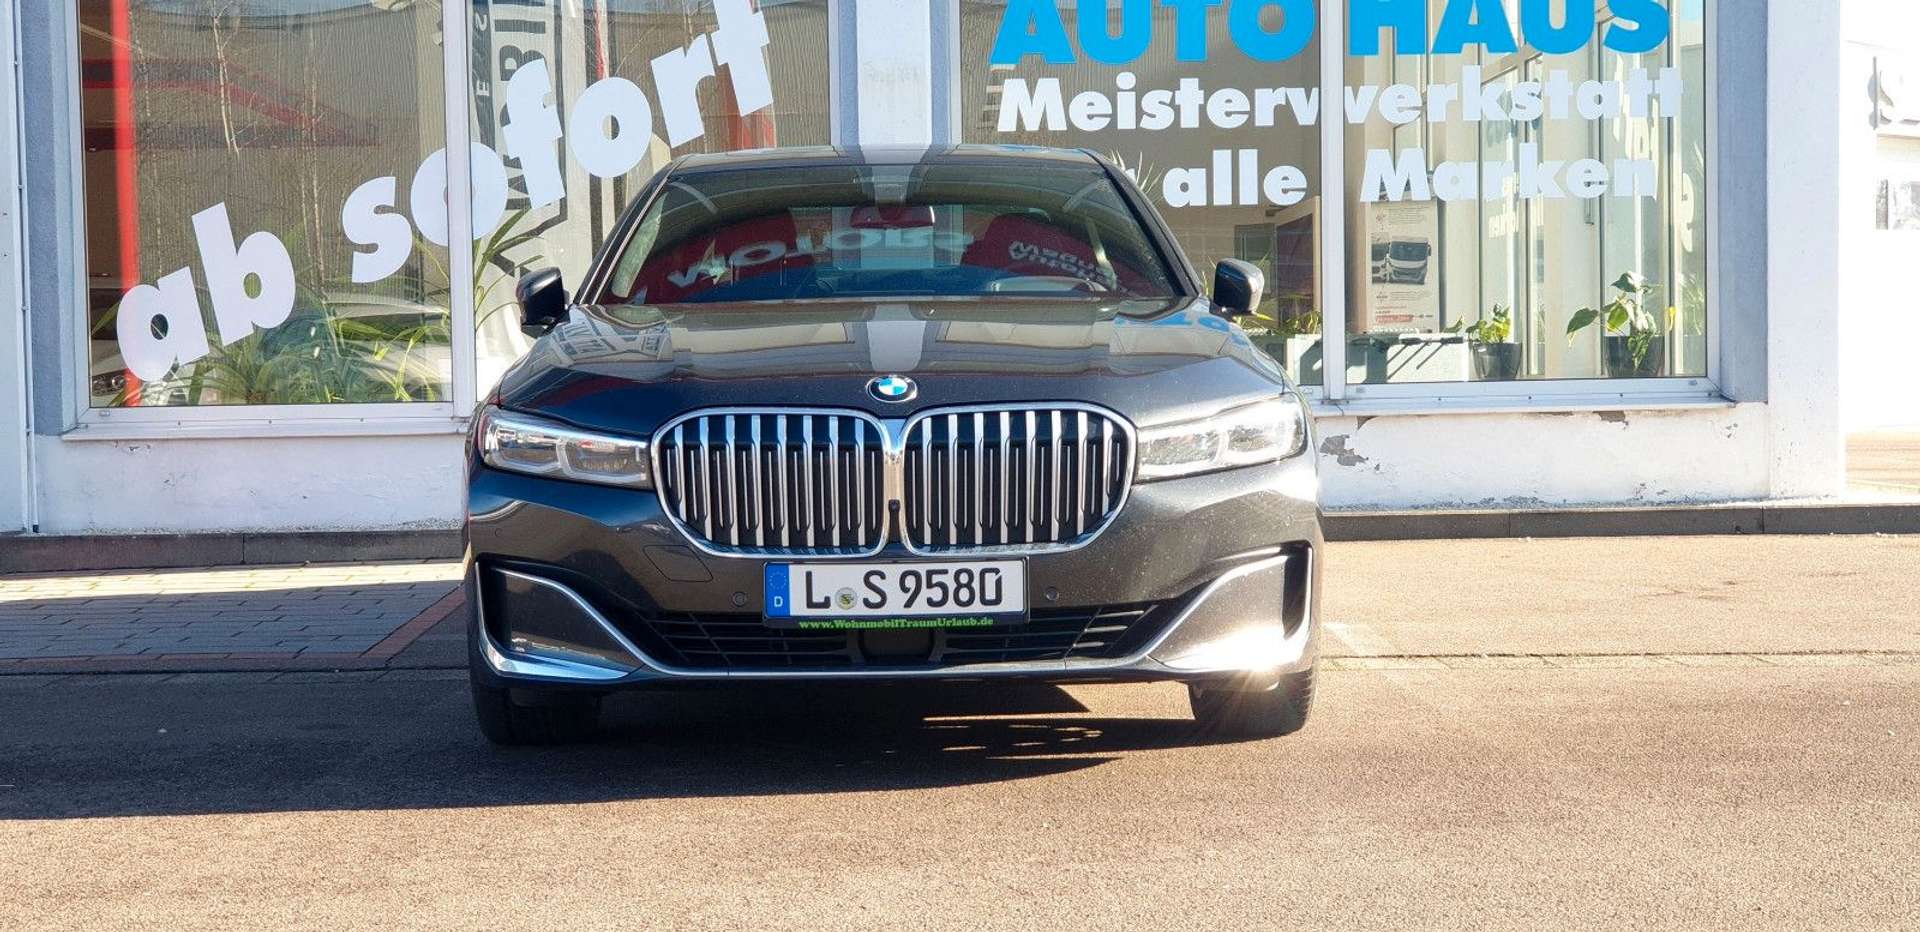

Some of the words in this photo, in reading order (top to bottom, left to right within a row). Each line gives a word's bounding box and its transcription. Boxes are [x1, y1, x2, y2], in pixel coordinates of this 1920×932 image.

[988, 0, 1317, 64] AUTO
[1348, 0, 1669, 55] HAUS
[117, 202, 296, 382] ab
[342, 0, 770, 283] sofort
[1162, 149, 1308, 208] alle
[1360, 143, 1658, 202] Marken
[774, 596, 783, 607] D
[805, 570, 831, 609] L
[862, 569, 888, 609] S
[899, 567, 1003, 609] 9580
[799, 616, 995, 630] www.WohnmobilTraumUrlaub.de
